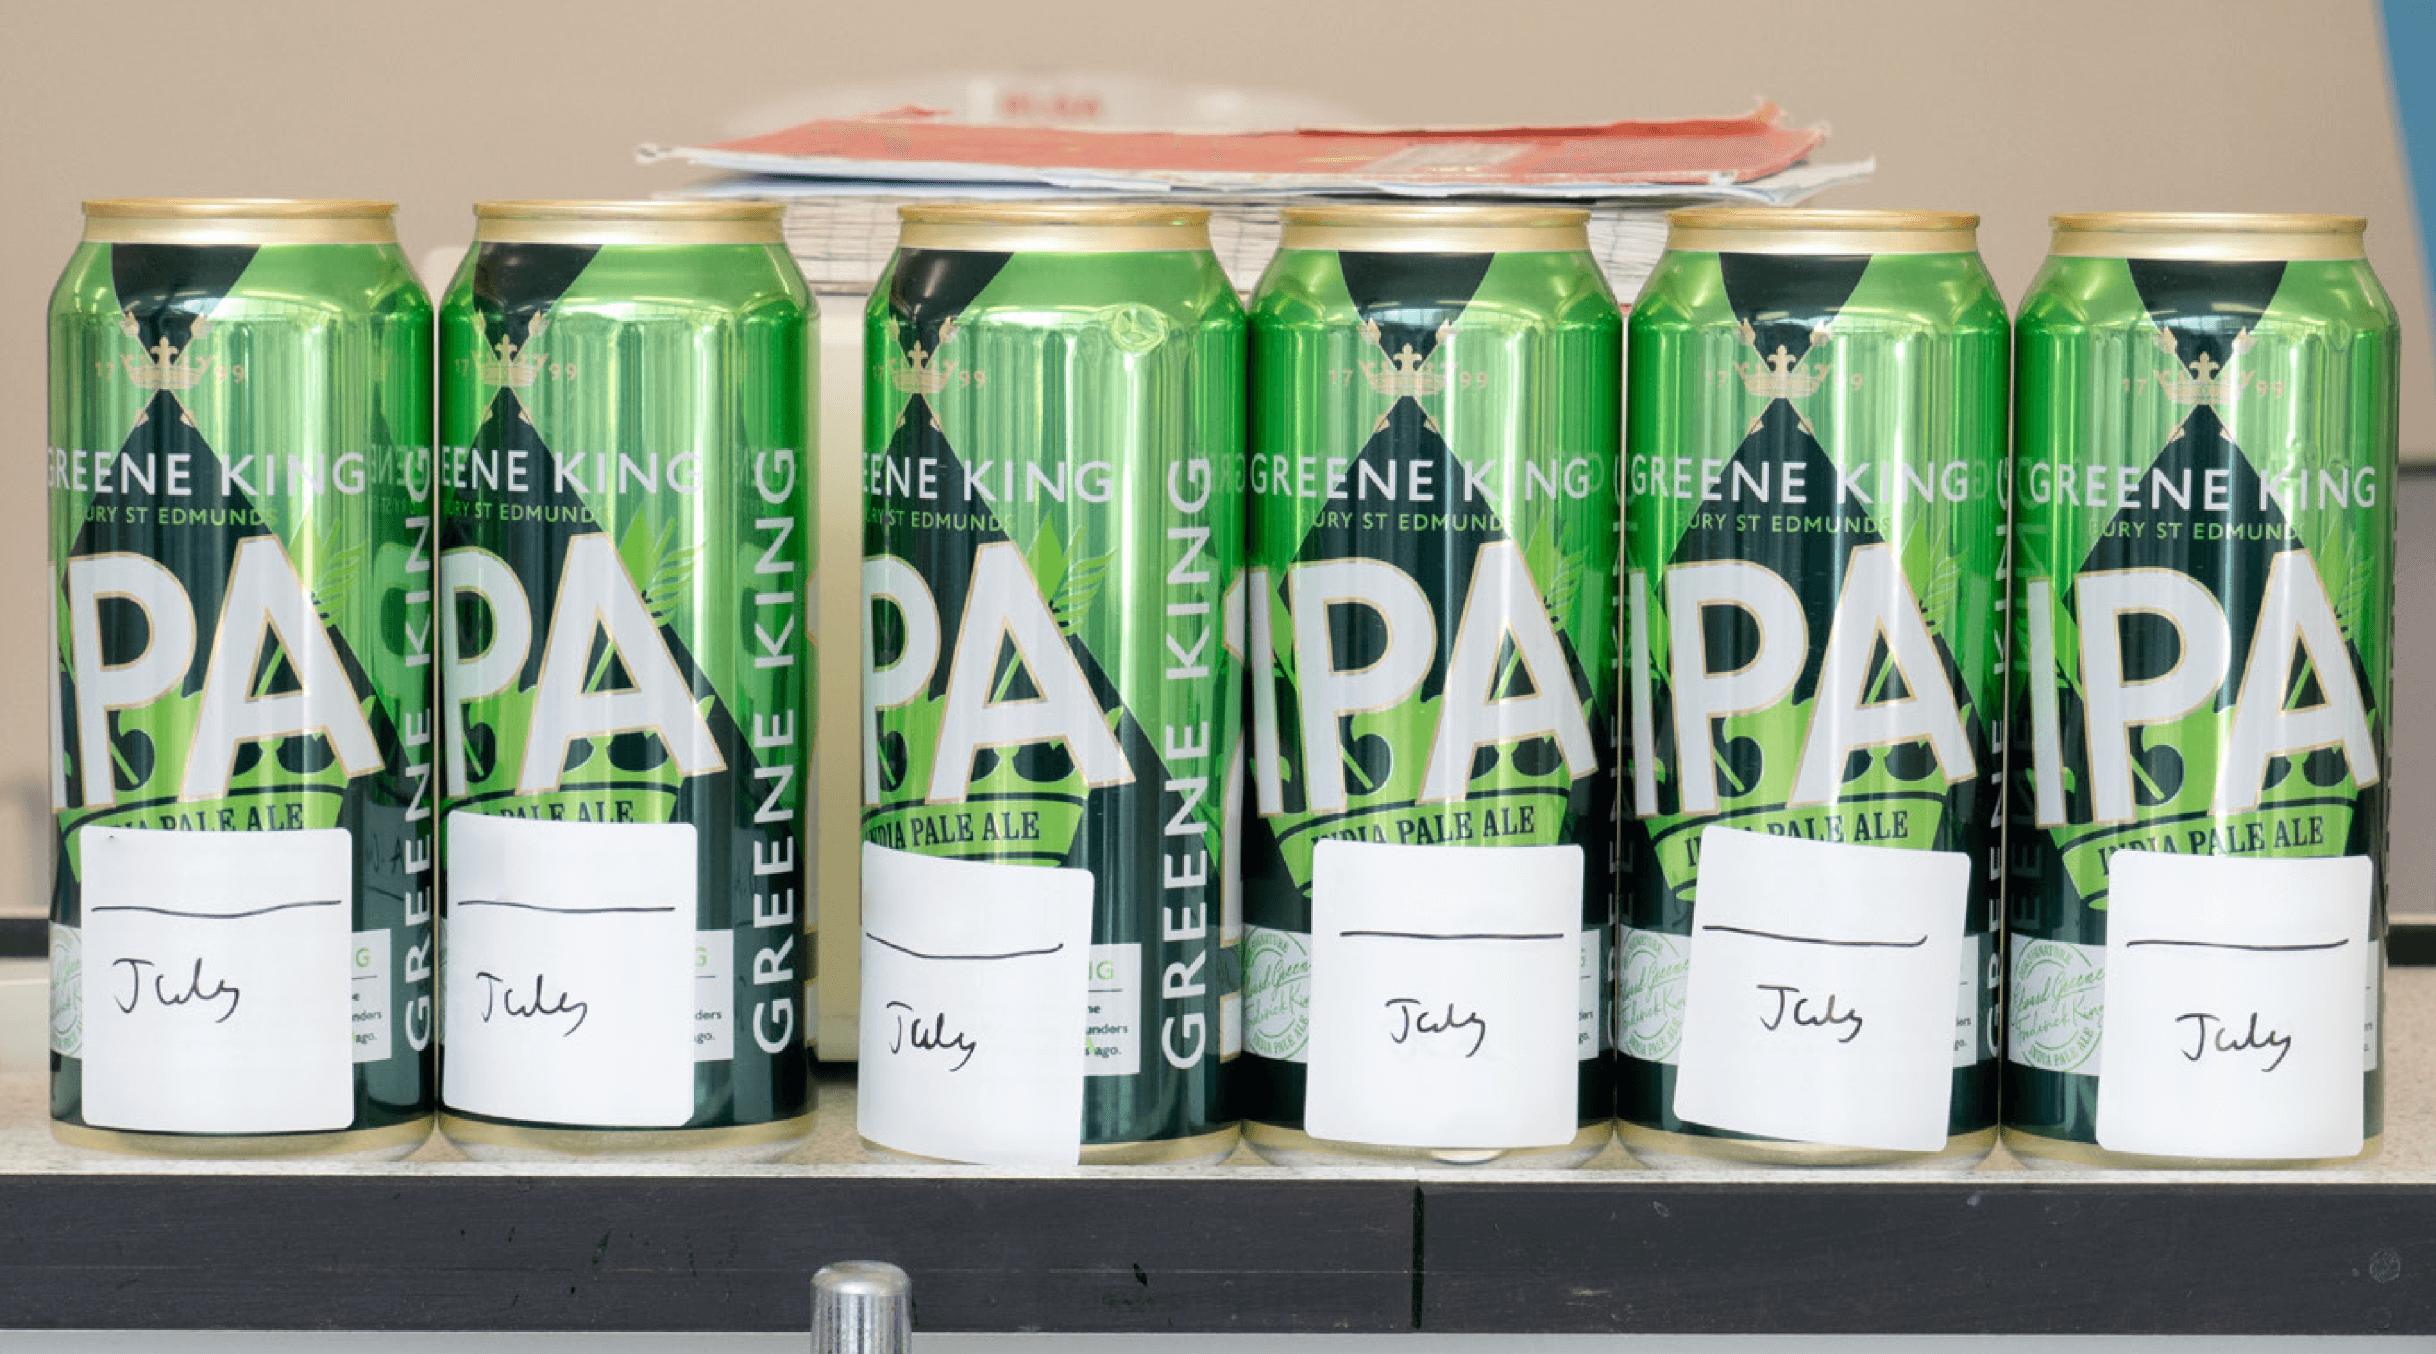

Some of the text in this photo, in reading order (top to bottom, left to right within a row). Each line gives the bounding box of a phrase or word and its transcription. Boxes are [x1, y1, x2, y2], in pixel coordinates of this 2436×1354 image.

[959, 370, 986, 389] 99
[221, 452, 366, 497] KING
[440, 446, 529, 492] EENE
[554, 452, 703, 494] KING
[963, 458, 1114, 503] KING
[1250, 454, 1435, 502] GREENE
[1464, 458, 1590, 502] KING
[1630, 453, 1969, 505] GREENE KING
[2029, 462, 2376, 511] GREENE KING
[126, 506, 148, 525] ST
[1362, 513, 1388, 530] ST
[1736, 514, 1761, 532] ST
[1772, 515, 1893, 534] EDMUNDS
[2157, 522, 2183, 540] ST
[1249, 539, 1599, 819] IPA
[1629, 542, 1978, 820] IPA
[2027, 548, 2381, 829] IPA
[405, 447, 431, 1052] GREENE KING
[753, 448, 795, 1053] GREENE KING
[1161, 457, 1211, 1069] GREENE KING
[246, 803, 305, 831] ALE
[911, 813, 974, 847] PALE
[982, 811, 1040, 841] ALE
[1396, 811, 1473, 844] PALE
[1483, 806, 1535, 837] ALE
[1854, 810, 1909, 842] ALE
[2188, 822, 2265, 851] PALE
[2275, 816, 2324, 848] ALE
[112, 957, 239, 1023] July
[476, 971, 588, 1036] July
[1757, 984, 1862, 1043] July
[887, 1000, 977, 1072] July
[1385, 998, 1486, 1057] July
[2176, 1012, 2292, 1073] July
